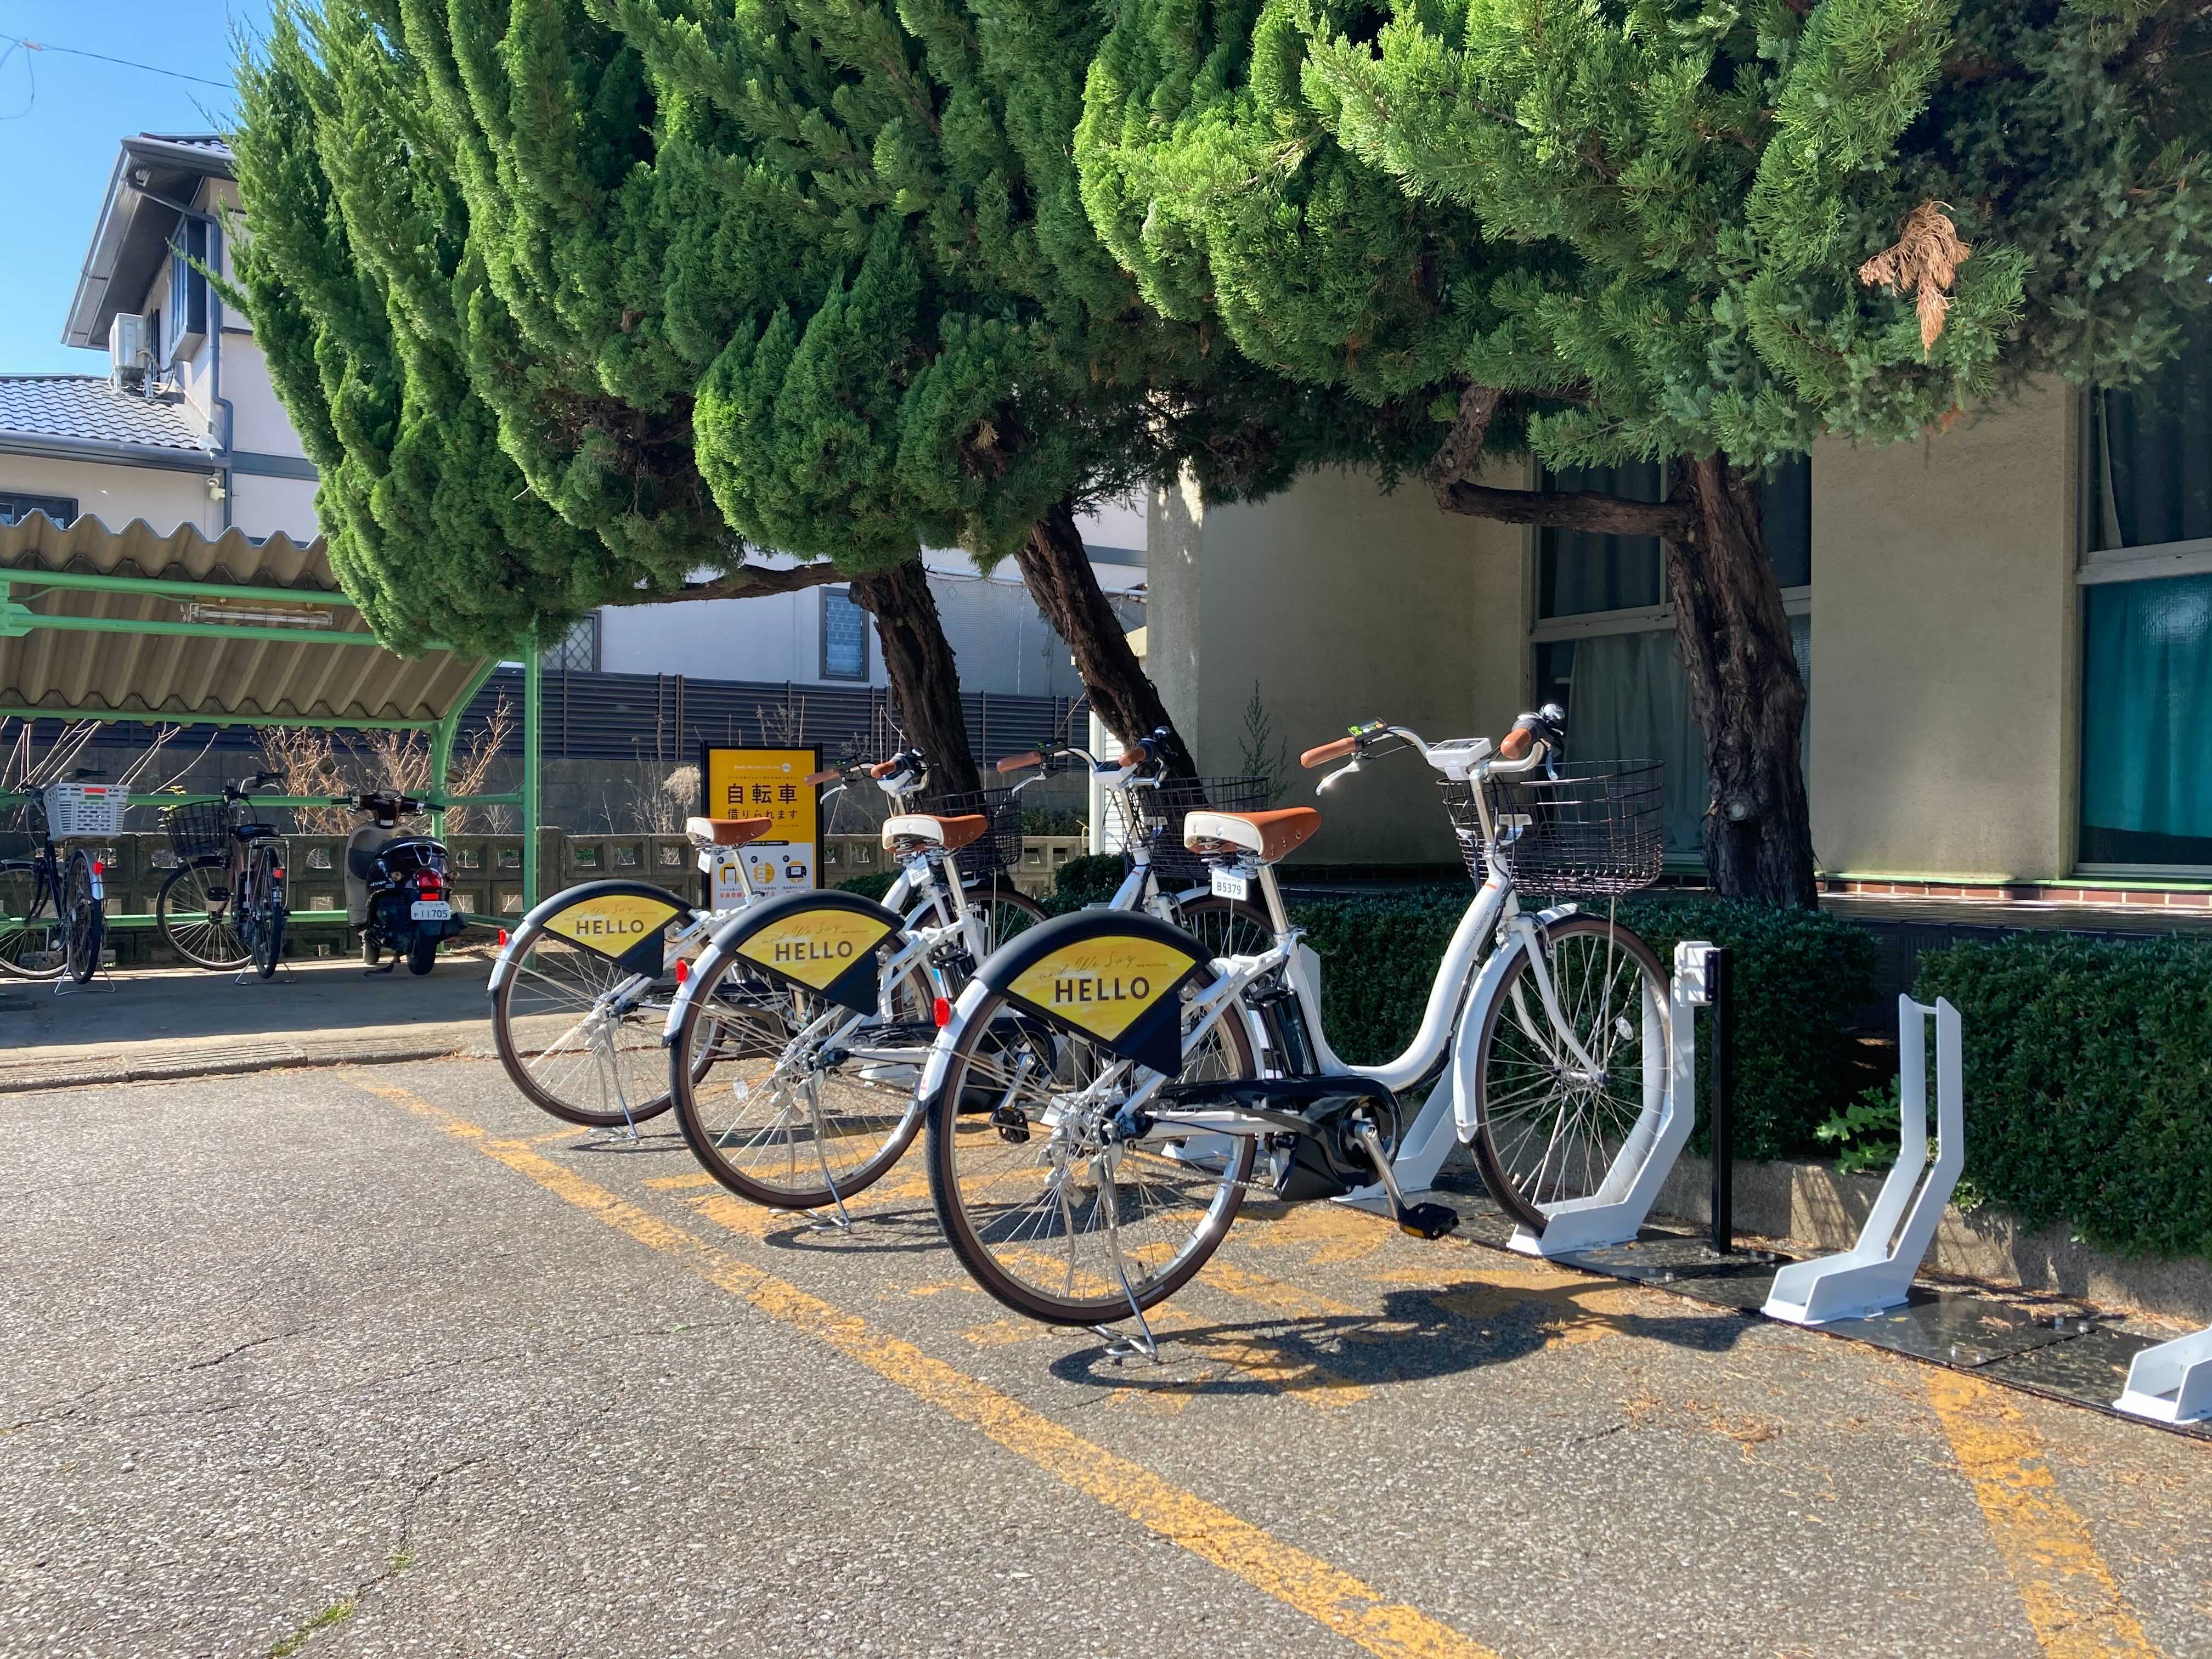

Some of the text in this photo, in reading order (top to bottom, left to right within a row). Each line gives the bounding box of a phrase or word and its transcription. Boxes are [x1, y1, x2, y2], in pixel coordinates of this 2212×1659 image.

[728, 783, 797, 804] 自転車
[727, 808, 798, 820] 借りられます
[1217, 882, 1241, 895] B5379
[576, 919, 644, 935] HELLO
[775, 940, 853, 961] HELLO
[1104, 951, 1136, 968] Say
[1056, 977, 1149, 1003] HELLO
